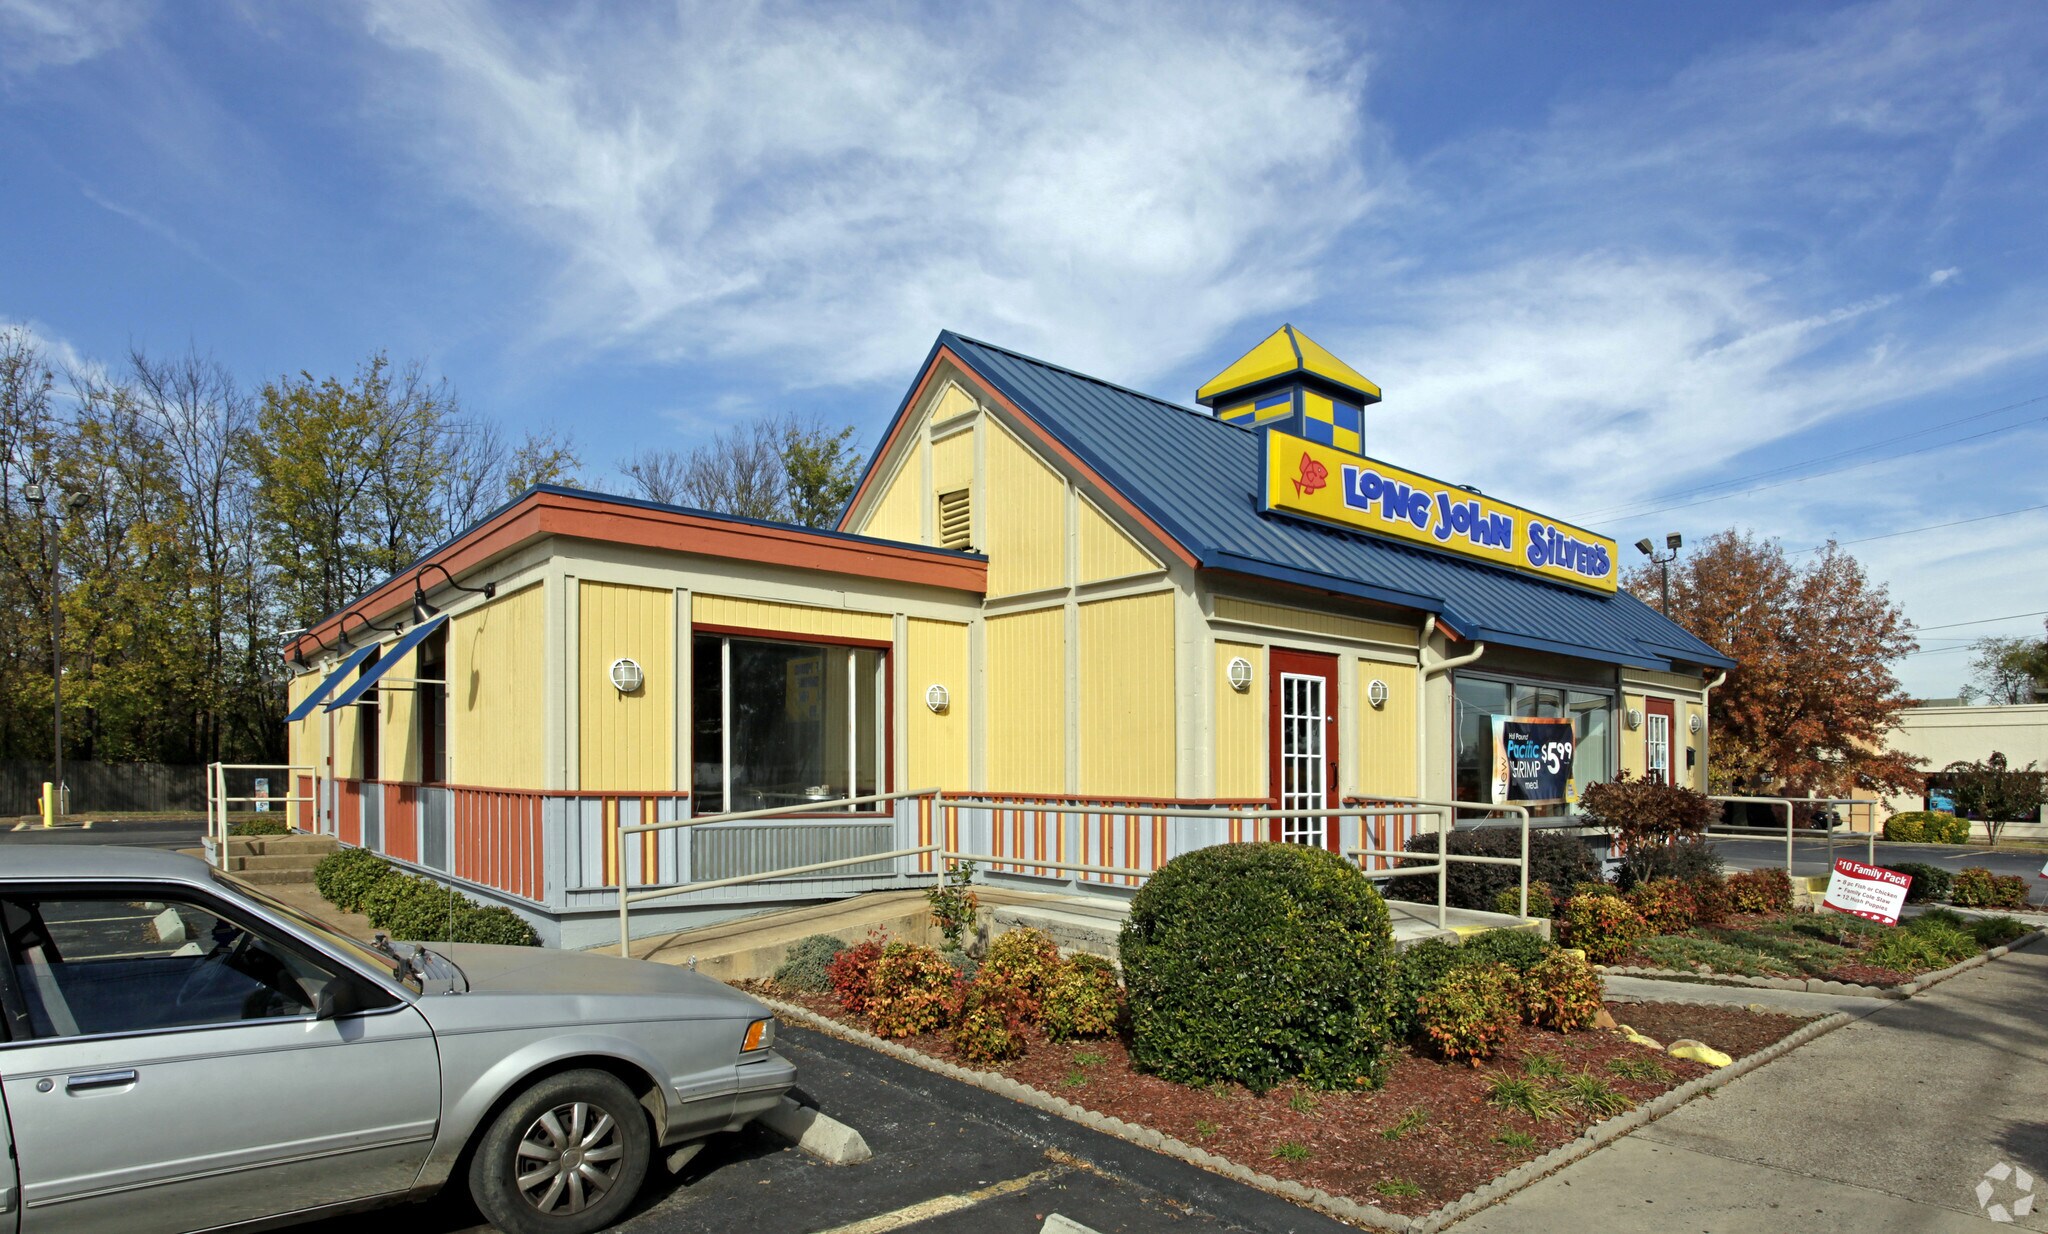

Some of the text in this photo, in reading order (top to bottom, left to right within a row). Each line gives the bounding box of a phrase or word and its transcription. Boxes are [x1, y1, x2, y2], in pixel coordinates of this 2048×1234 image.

[1342, 465, 1432, 530] LONG
[1508, 740, 1539, 758] Pacific
[1510, 761, 1541, 778] SHRIMP
[1525, 780, 1539, 789] meal
[1839, 860, 1907, 886] $10 Family Pack
[1844, 887, 1891, 905] Family Cole Slaw
[1854, 882, 1867, 890] Fish
[1874, 888, 1898, 899] Chicken
[1850, 896, 1864, 904] Hush
[1865, 900, 1888, 912] Puppies
